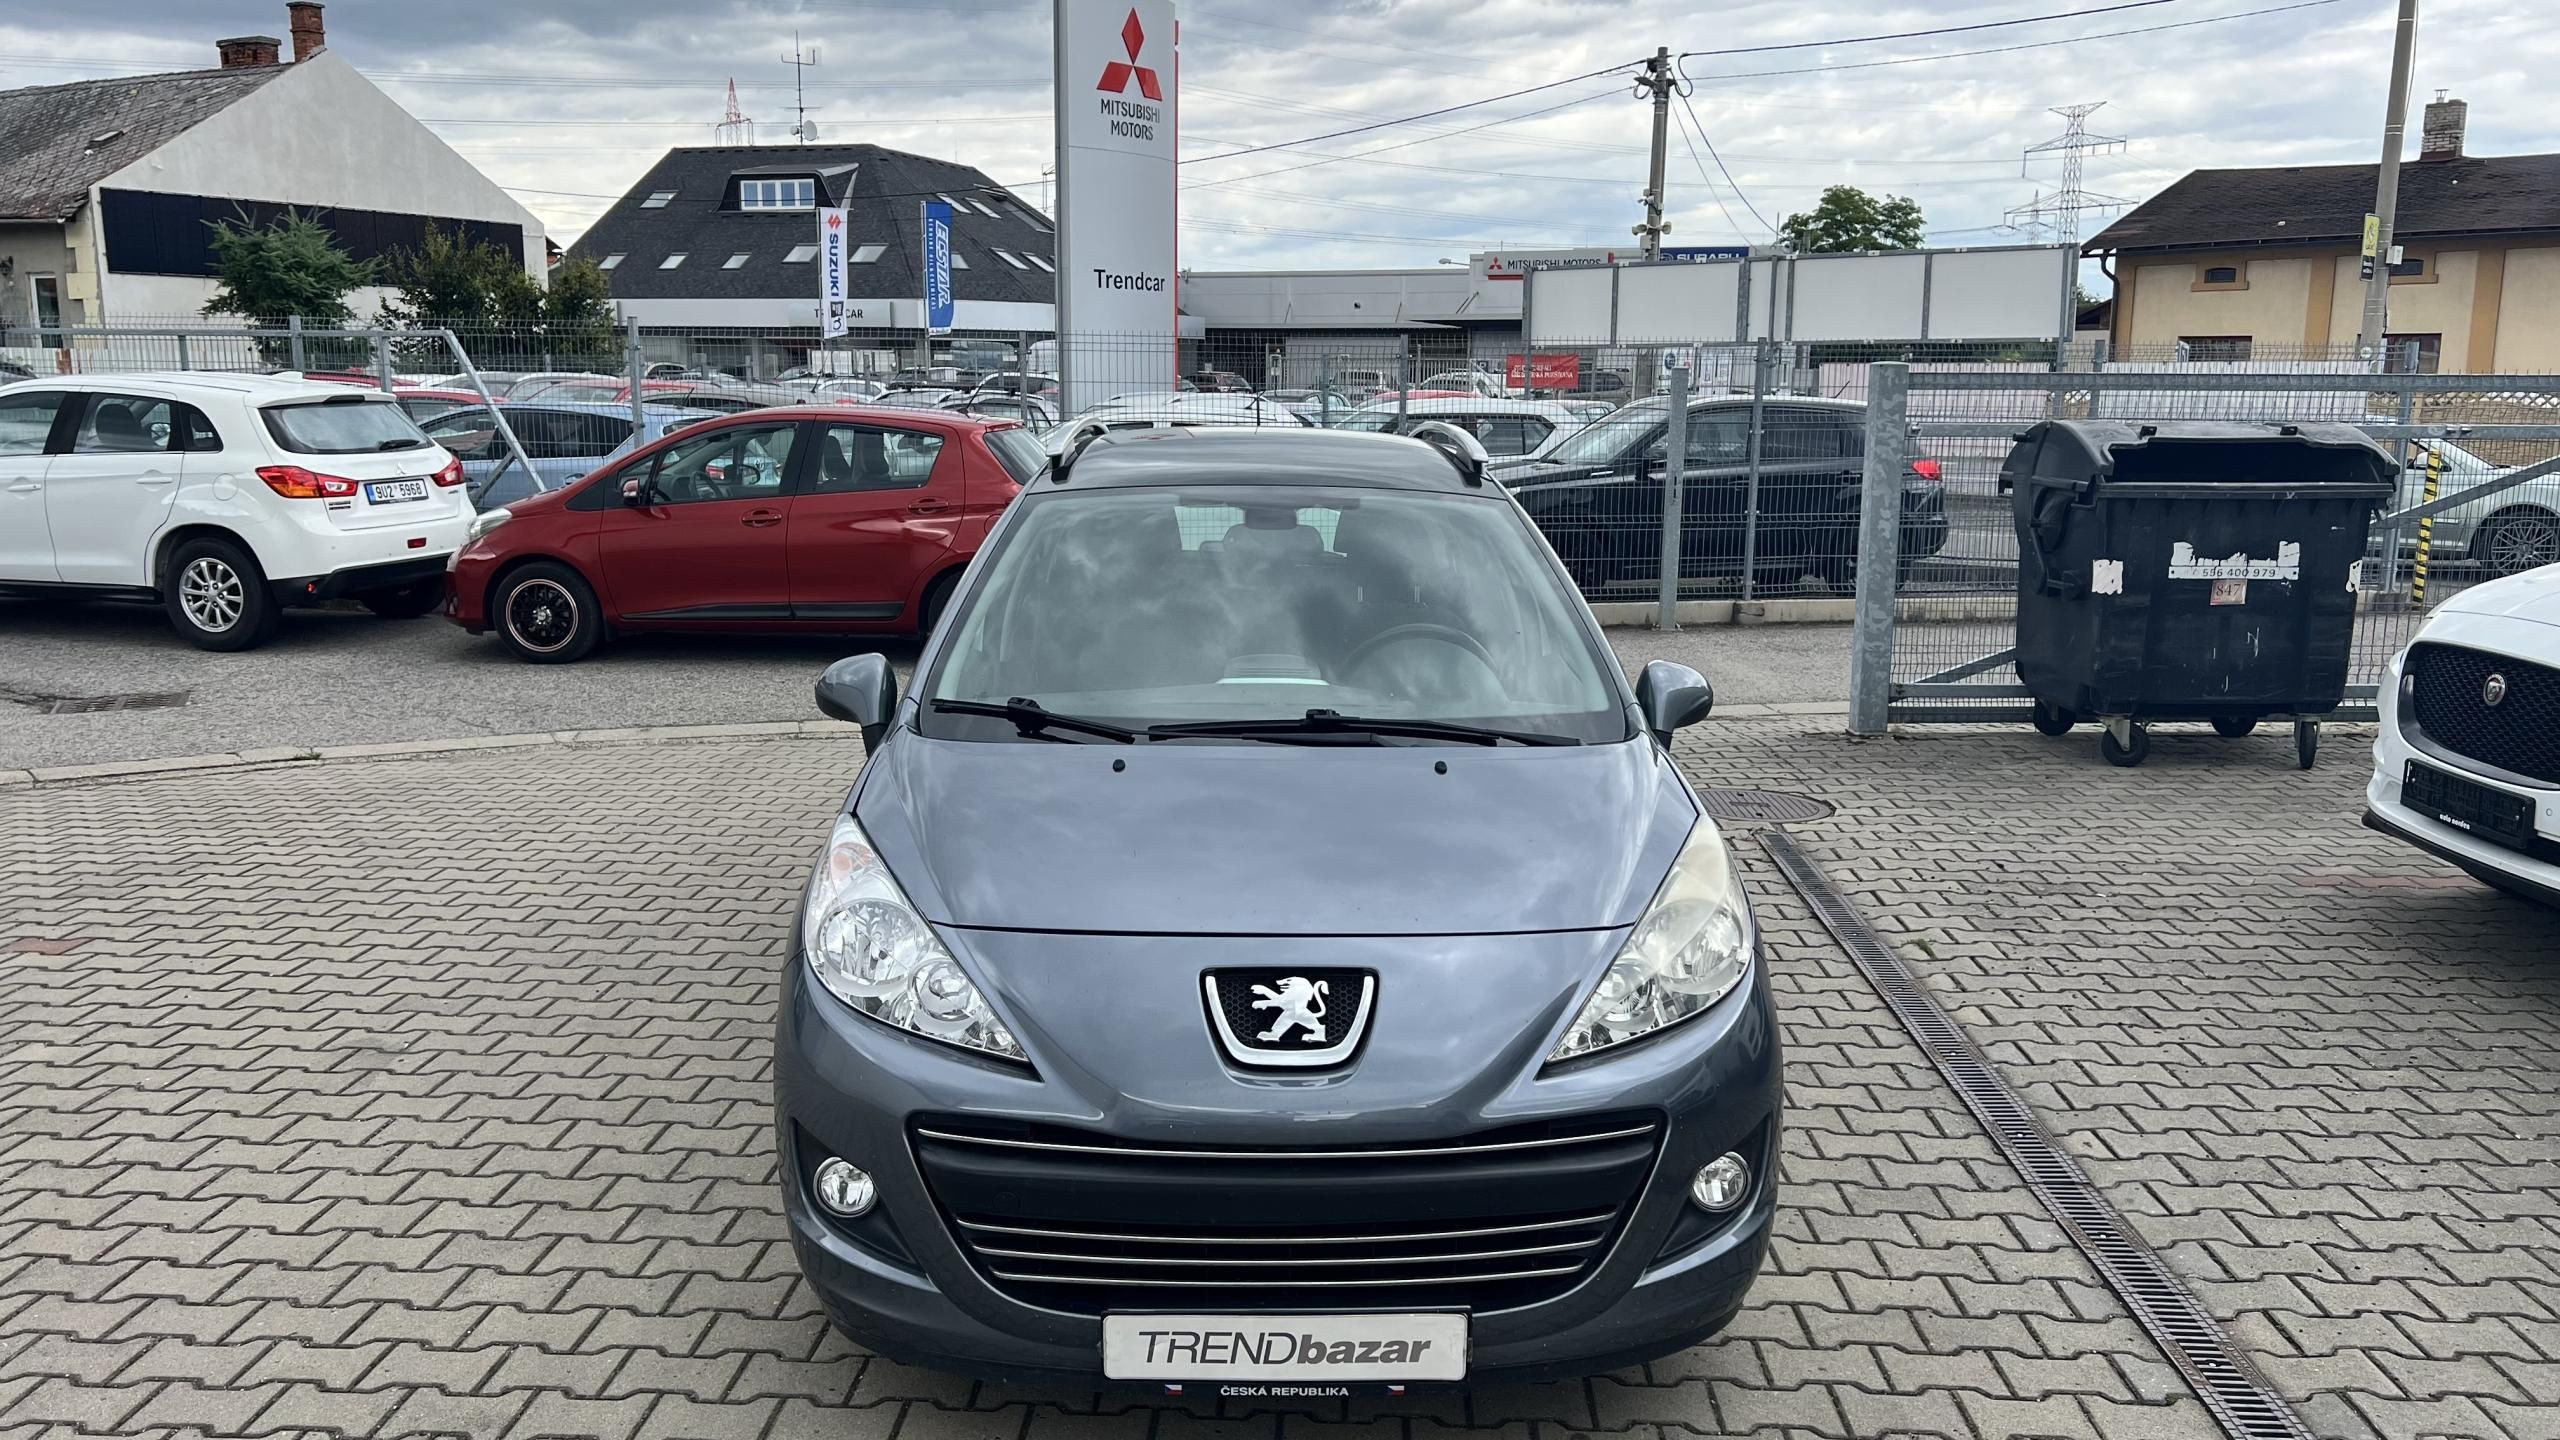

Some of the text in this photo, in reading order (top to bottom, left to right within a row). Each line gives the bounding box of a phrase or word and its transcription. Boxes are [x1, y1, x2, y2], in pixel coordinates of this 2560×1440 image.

[1100, 98, 1160, 123] MITSUBISHI
[1110, 119, 1154, 141] MOTORS
[829, 233, 840, 297] SUZUKI
[935, 220, 951, 308] ECSTAR
[1094, 268, 1165, 292] Trendcar
[375, 482, 422, 499] 9U2 5968
[2227, 568, 2249, 578] 400
[2253, 568, 2276, 578] 979
[2216, 584, 2241, 596] 847
[1139, 1331, 1432, 1364] TRENDbazar
[1220, 1384, 1350, 1397] ČESKÁ REPUBLIKA
